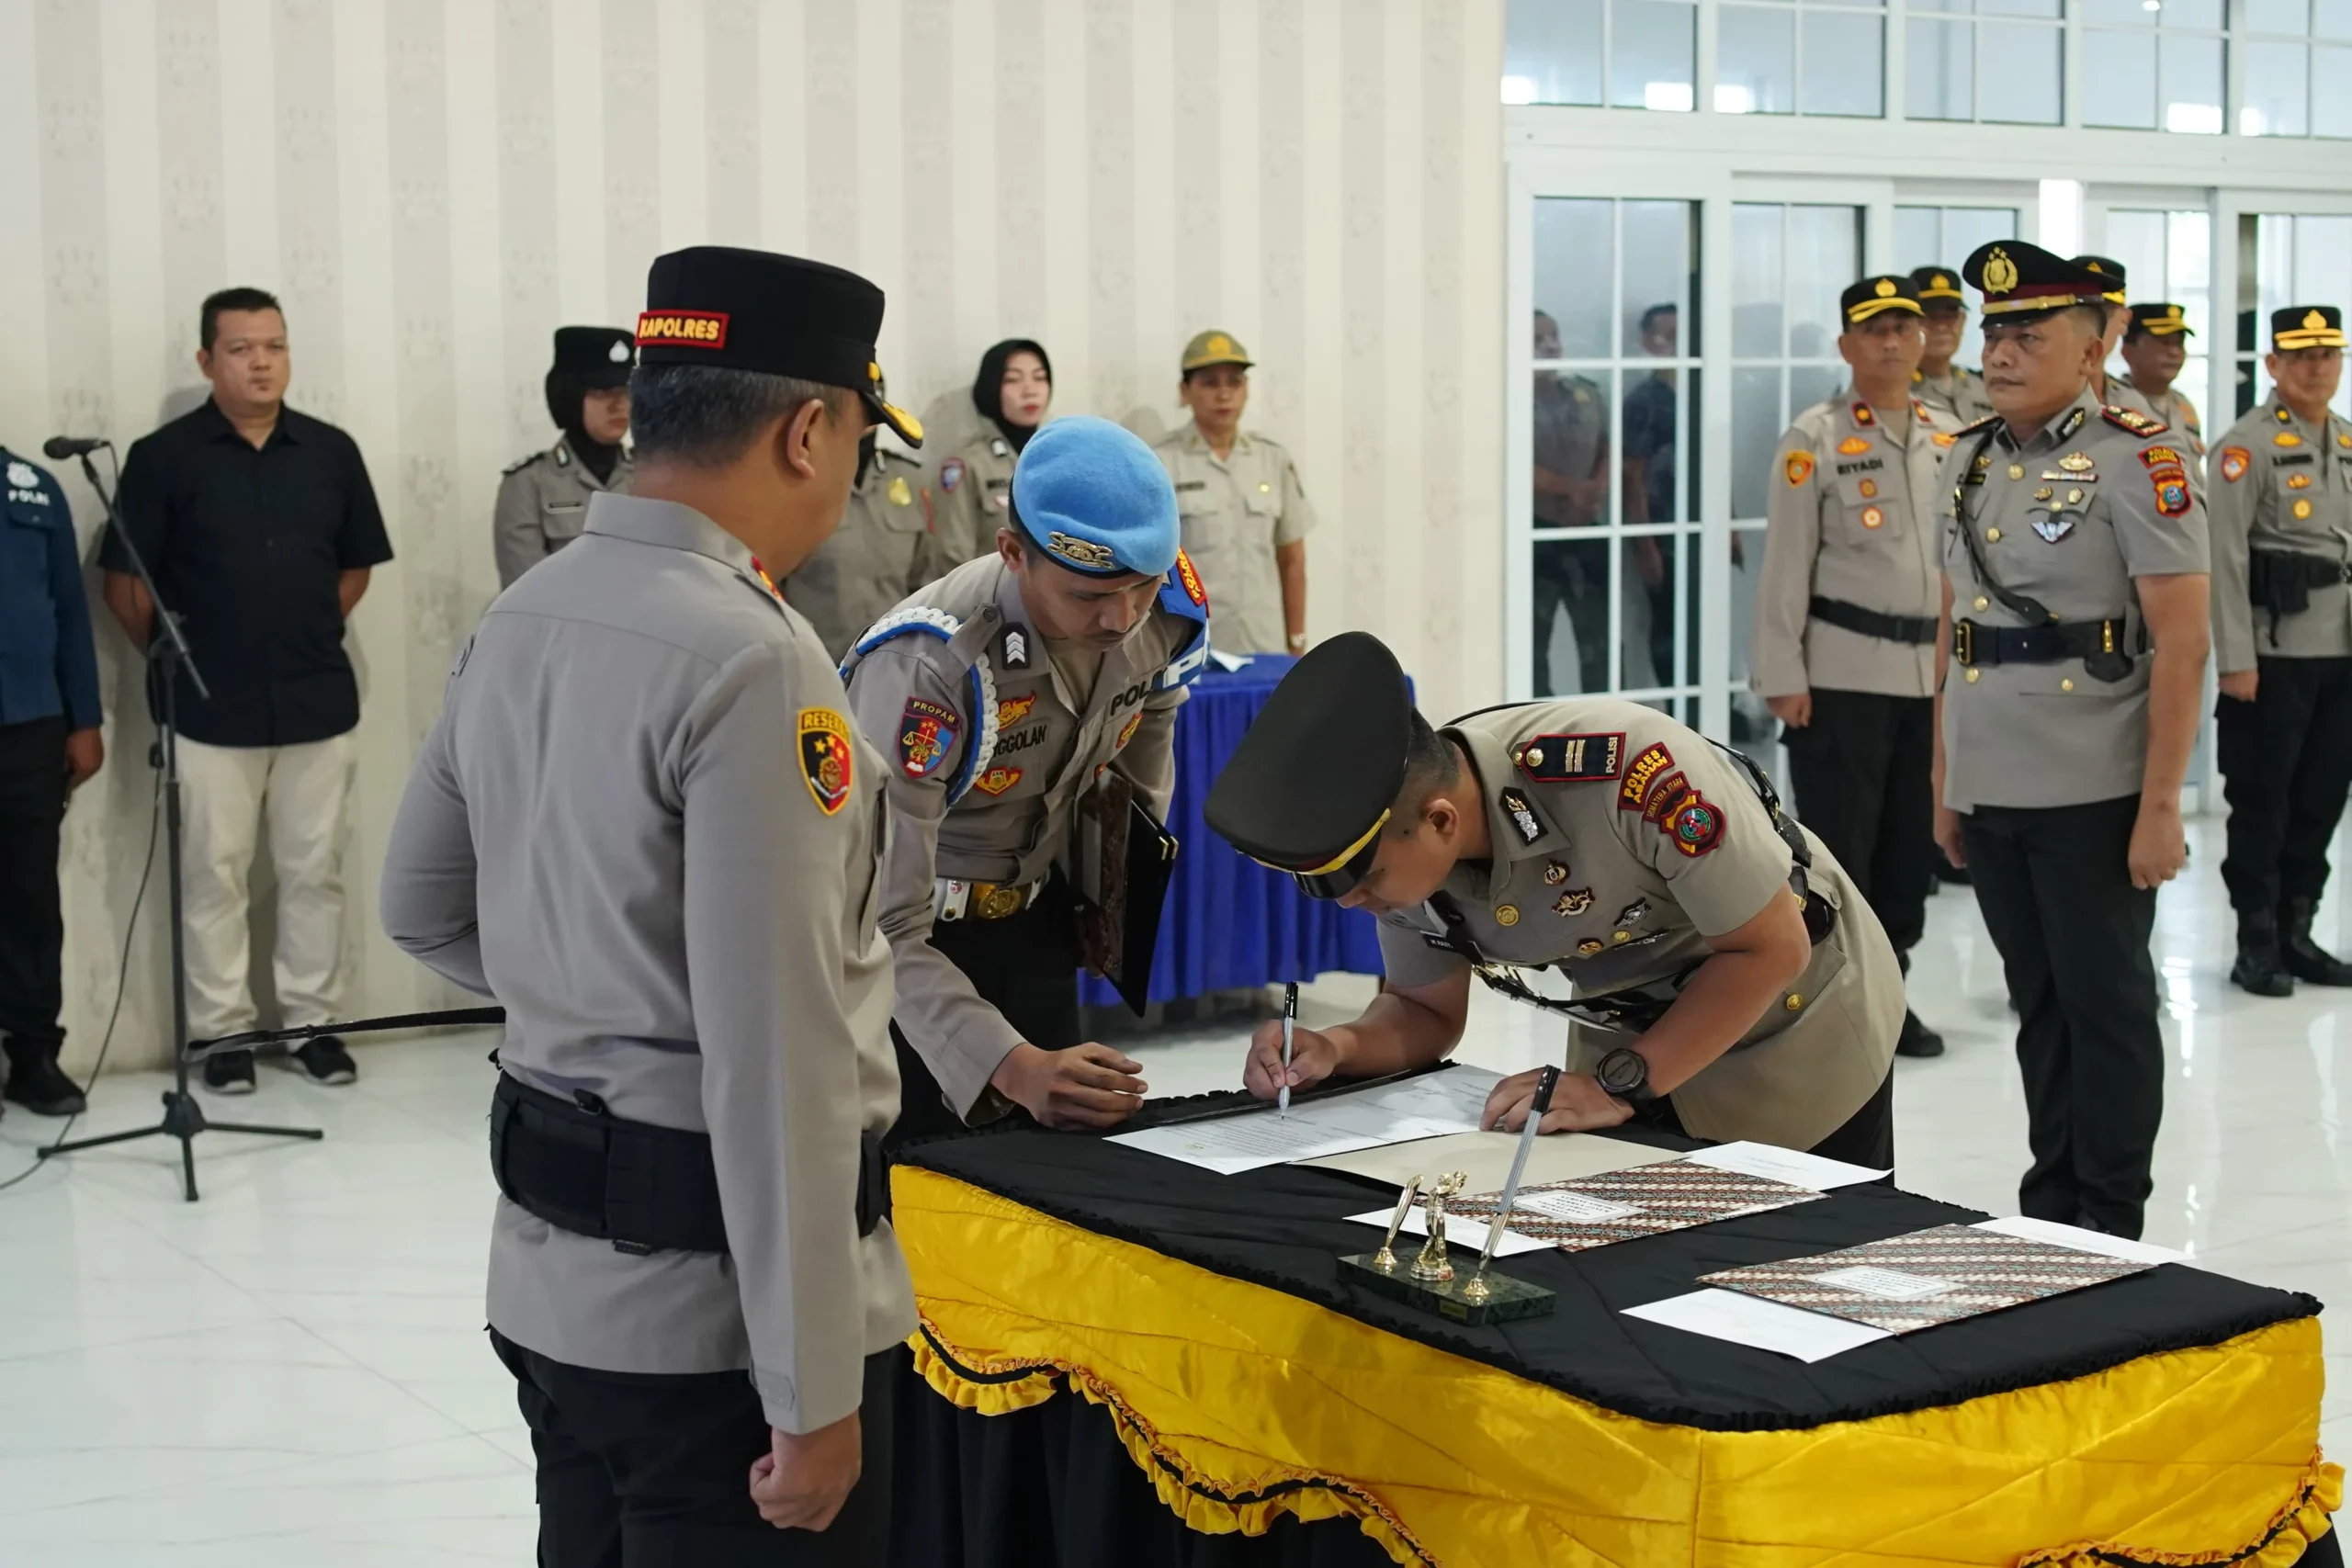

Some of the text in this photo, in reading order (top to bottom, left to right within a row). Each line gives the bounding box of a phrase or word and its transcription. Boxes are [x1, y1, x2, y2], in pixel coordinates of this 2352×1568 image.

[639, 317, 720, 341] KAPOLRES
[7, 489, 50, 506] POLRI
[912, 701, 956, 724] PROPAM
[1605, 736, 1619, 773] POLISI
[1623, 750, 1661, 798] POLRES
[1633, 755, 1668, 805] ASAHAN
[1645, 776, 1684, 818] SUMATERA UTARA
